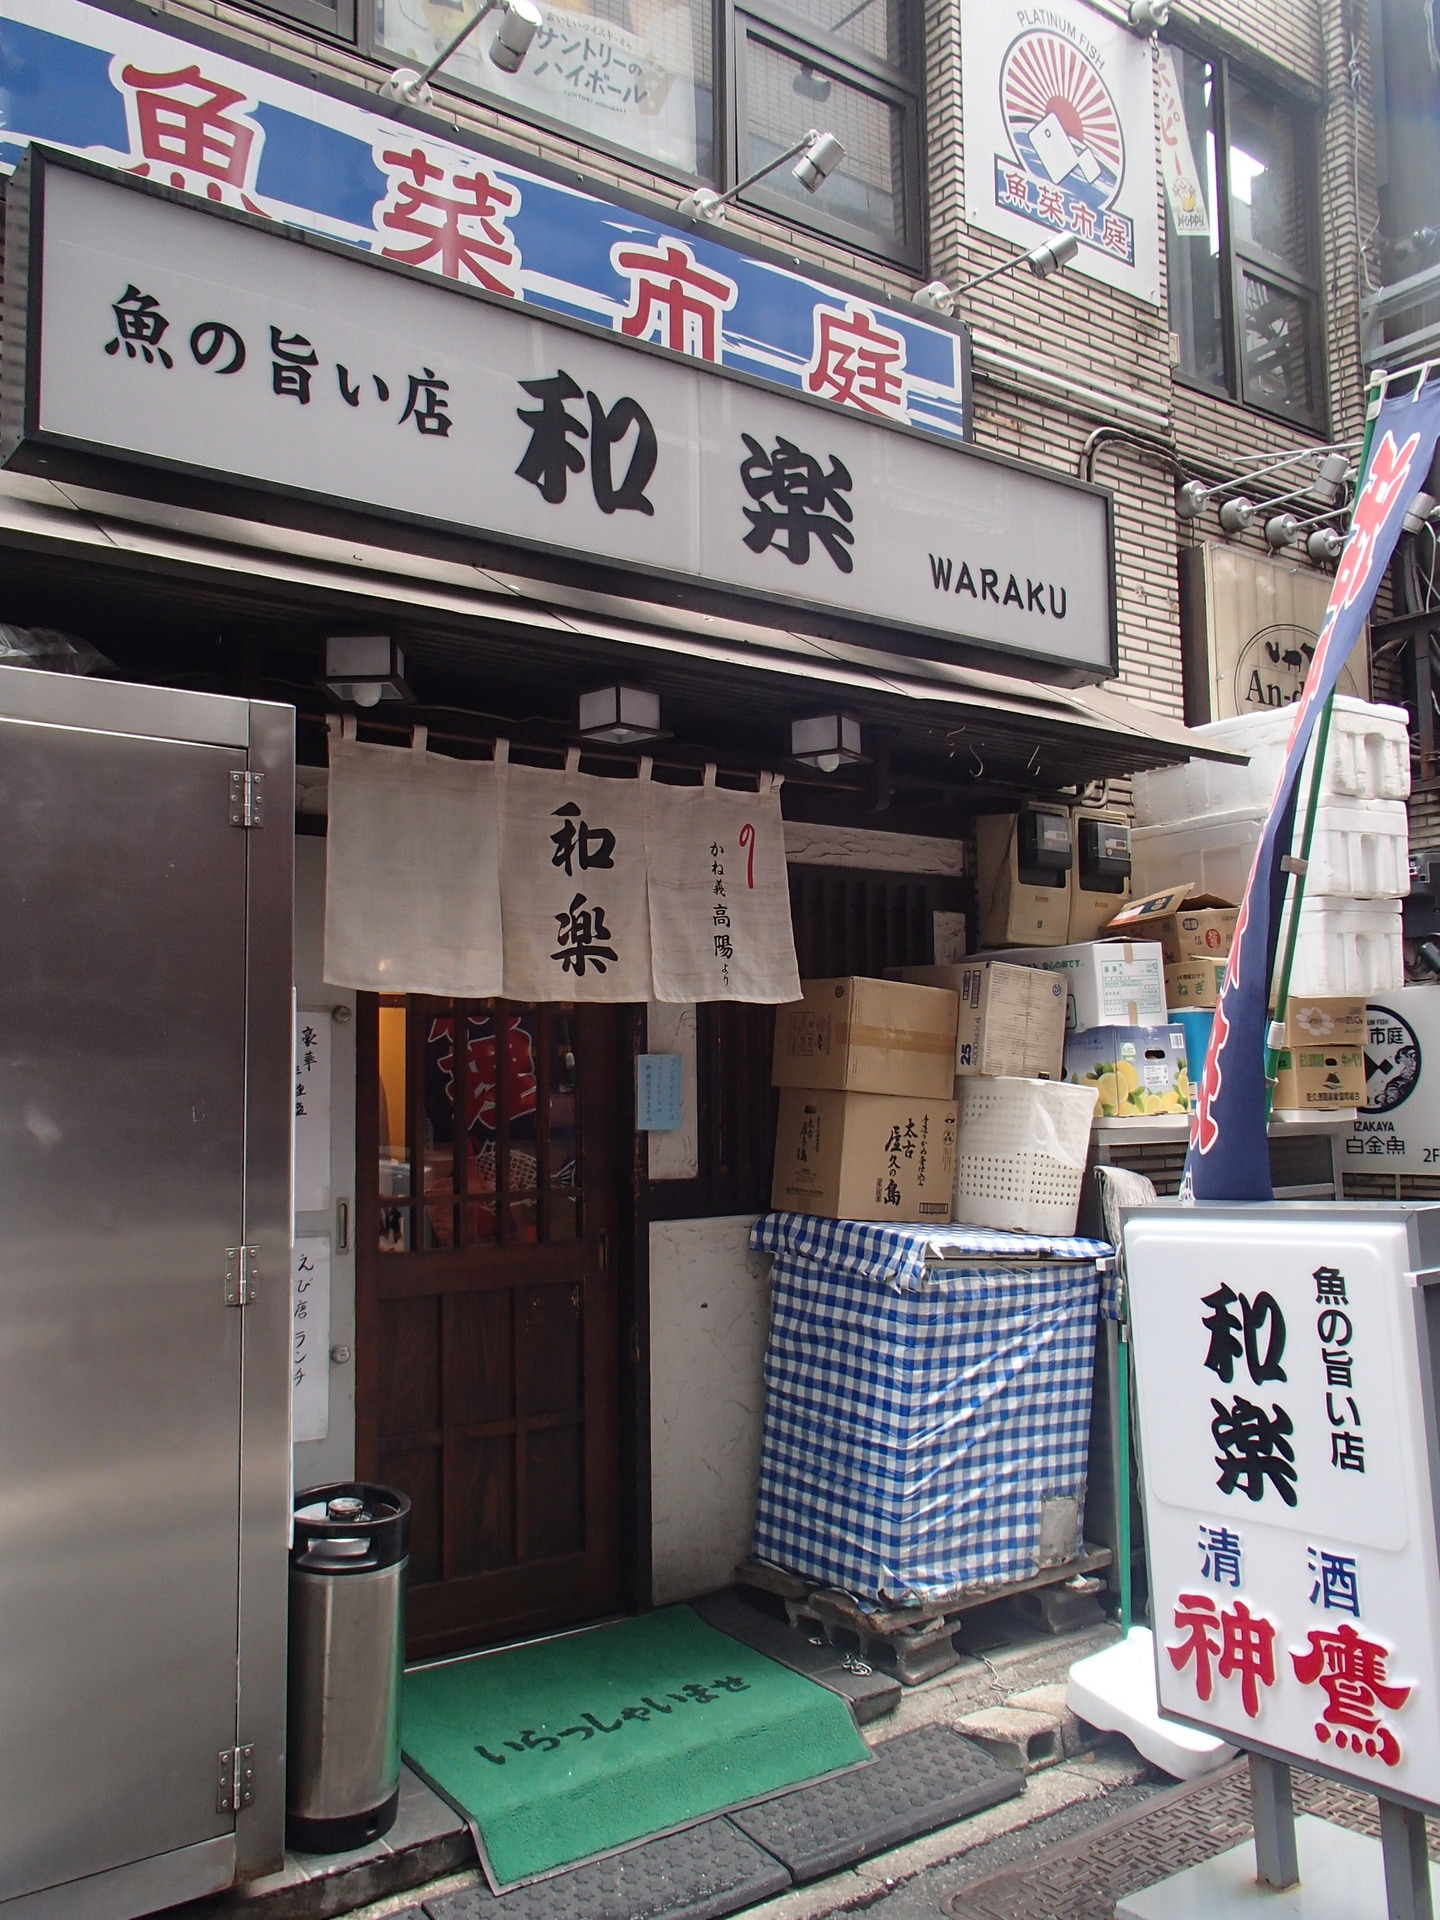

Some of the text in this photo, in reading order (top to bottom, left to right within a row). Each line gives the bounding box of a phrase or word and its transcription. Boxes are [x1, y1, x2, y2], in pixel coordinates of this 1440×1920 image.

[536, 26, 643, 76] サントリーの
[1017, 8, 1106, 70] PLATINUM FISH
[533, 60, 648, 104] ハイボール
[120, 63, 904, 421] 魚菜市庭
[1004, 172, 1128, 255] 魚菜市庭
[1177, 213, 1205, 229] HOPPY
[105, 284, 453, 438] 魚の旨い店
[515, 369, 854, 574] 和楽
[929, 553, 1068, 619] WARAKU
[550, 802, 618, 977] 和楽
[1177, 980, 1205, 996] ねぎ
[301, 1026, 318, 1072] 豪華
[960, 1043, 972, 1066] 25
[1369, 1026, 1404, 1045] 市庭
[1346, 1135, 1406, 1155] 白金魚
[1353, 1121, 1395, 1132] IZAKAYA
[1200, 1282, 1298, 1508] 和楽
[1312, 1266, 1366, 1474] 魚の旨い店
[1198, 1524, 1363, 1618] 清酒
[1166, 1594, 1412, 1768] 神鷹
[474, 1675, 751, 1766] いらっしゃいませ
